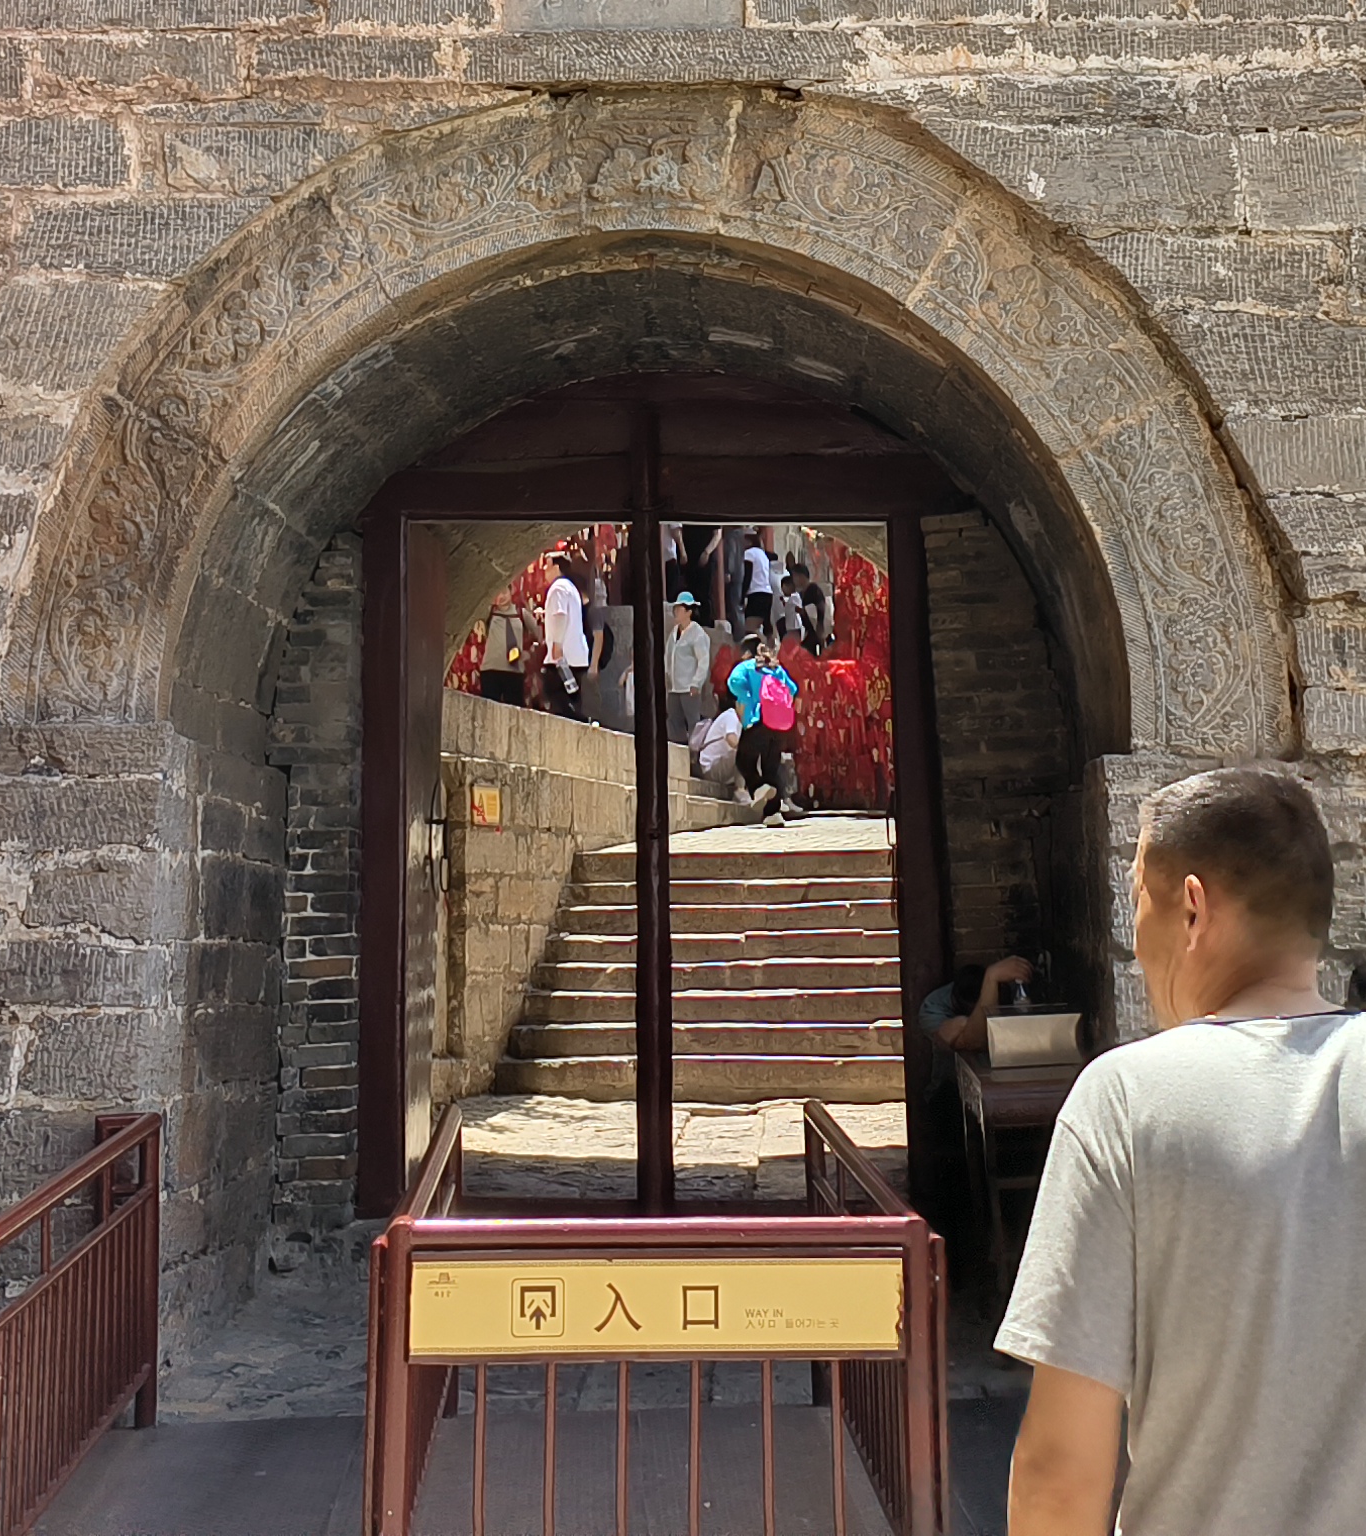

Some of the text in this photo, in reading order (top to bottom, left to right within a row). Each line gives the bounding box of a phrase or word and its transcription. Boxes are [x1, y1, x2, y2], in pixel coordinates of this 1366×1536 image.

[594, 1282, 721, 1333] 入口
[745, 1308, 784, 1318] WAY IN
